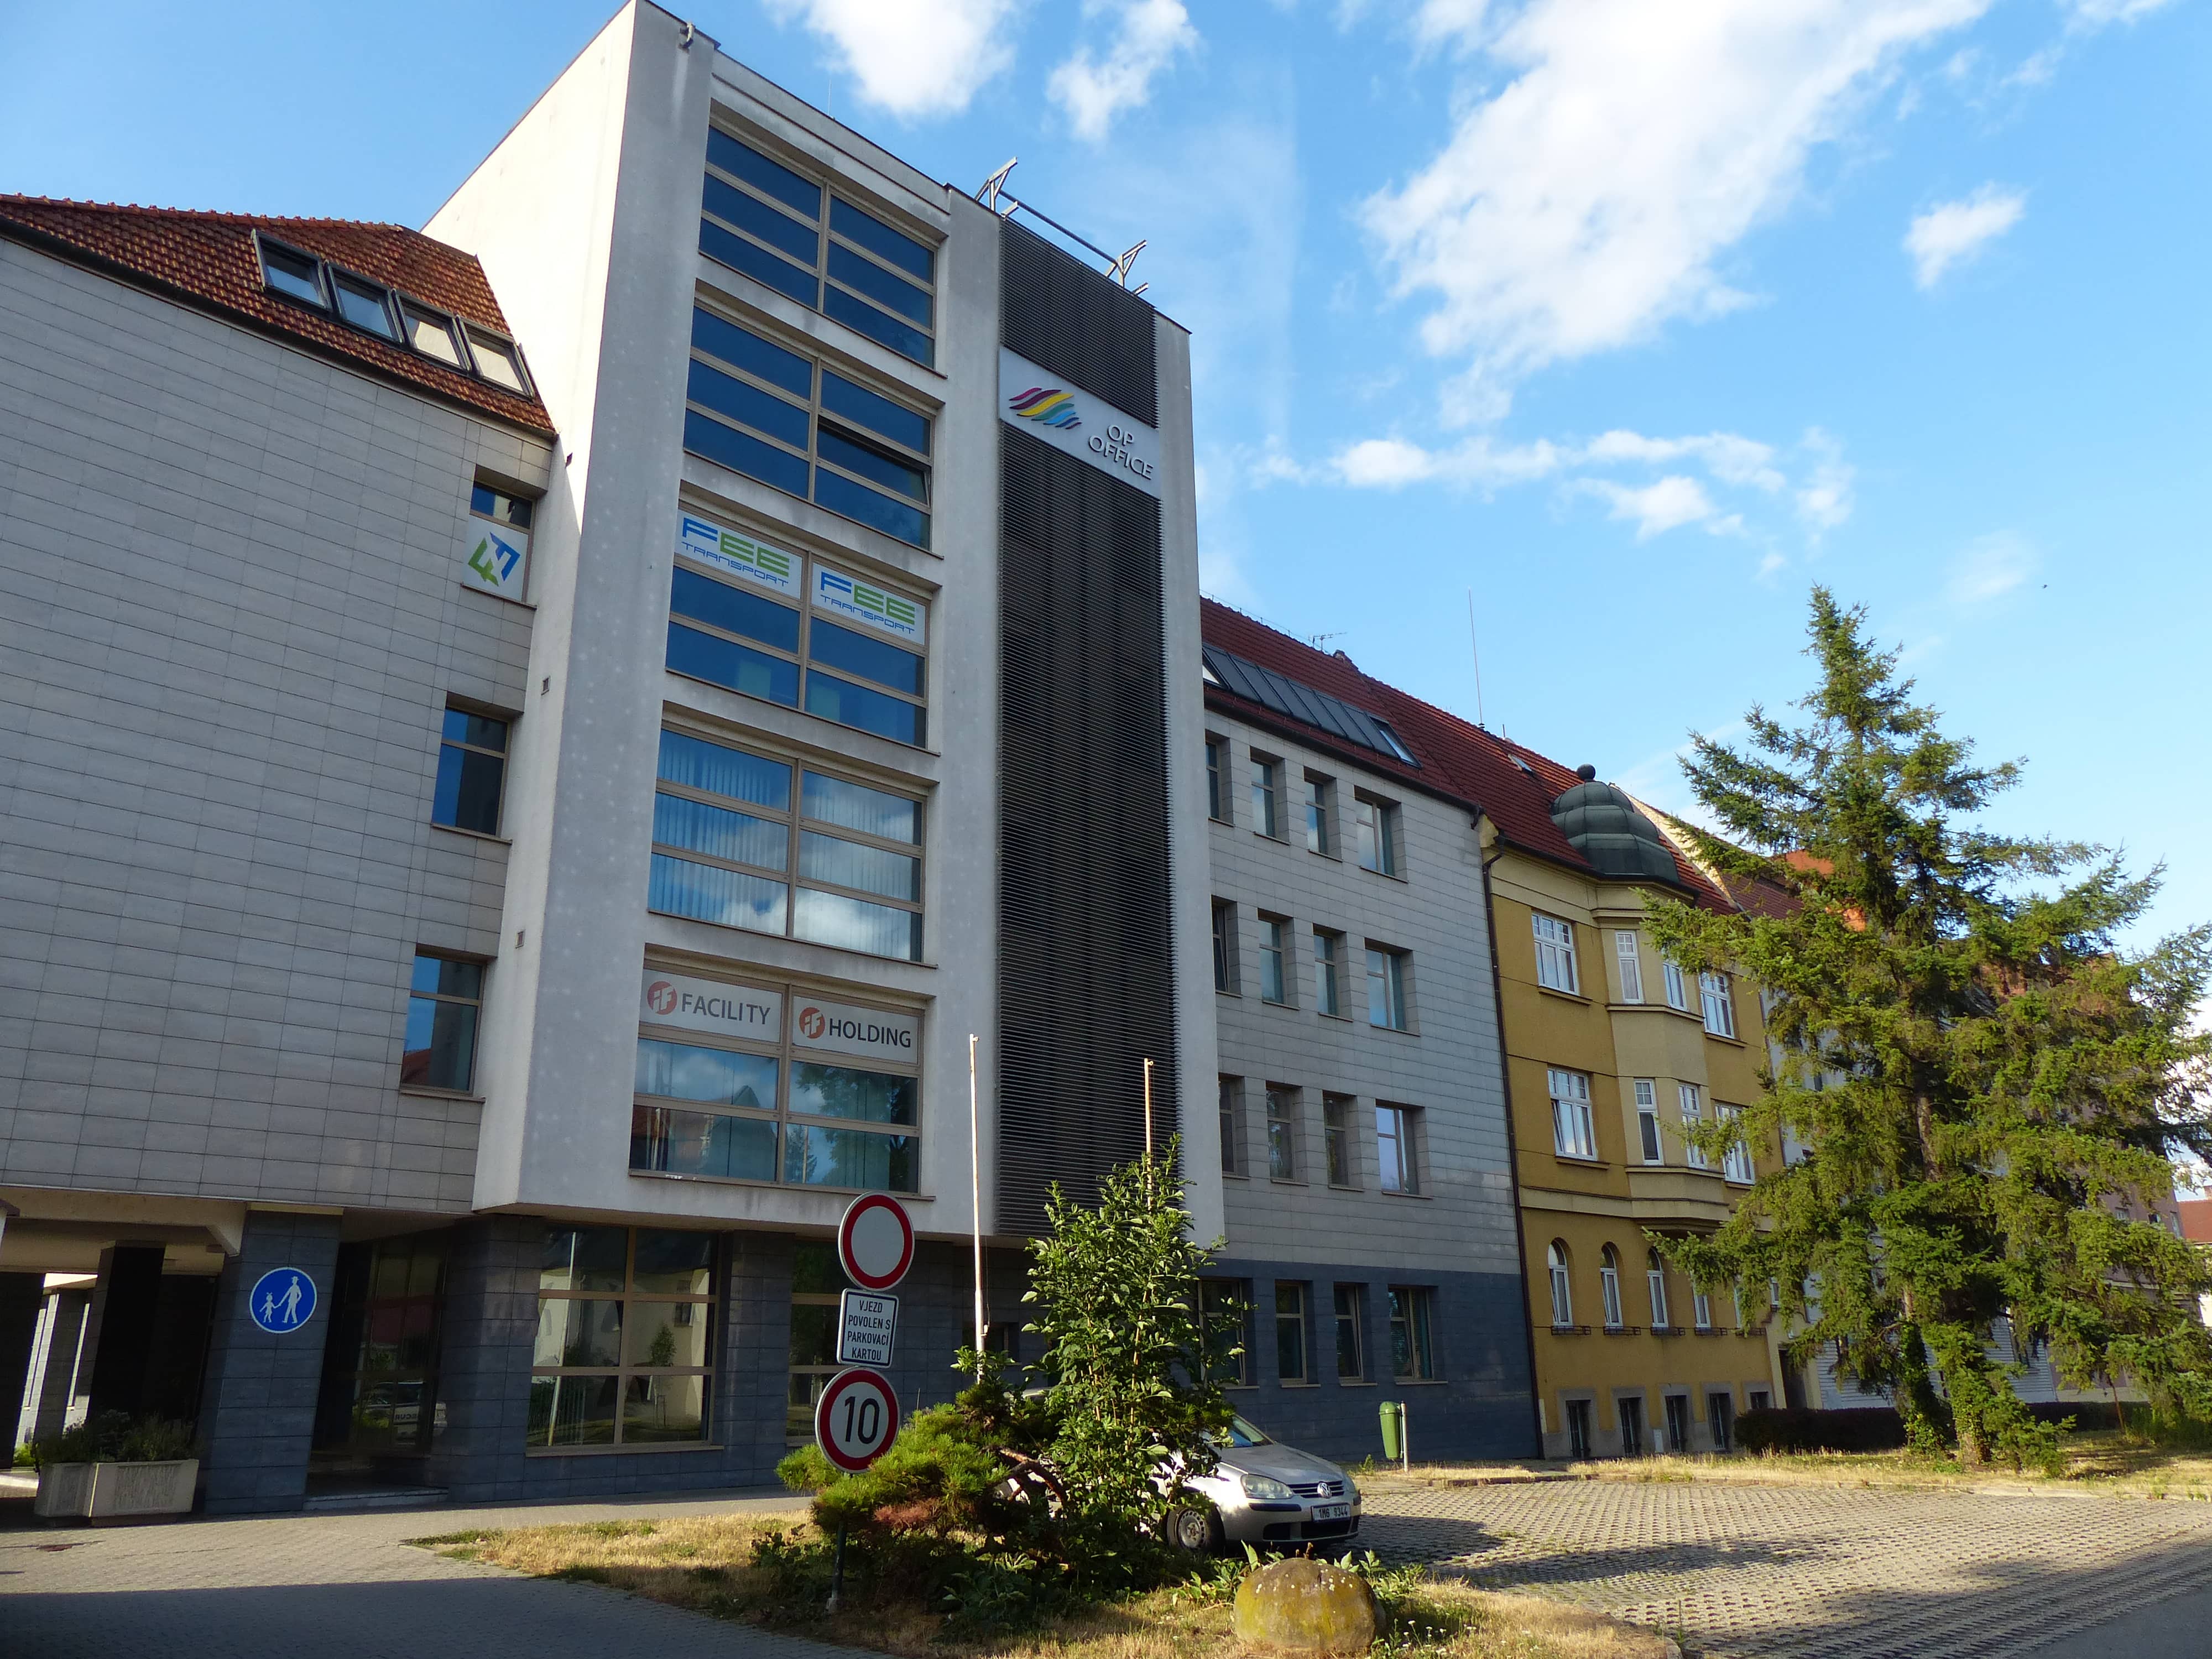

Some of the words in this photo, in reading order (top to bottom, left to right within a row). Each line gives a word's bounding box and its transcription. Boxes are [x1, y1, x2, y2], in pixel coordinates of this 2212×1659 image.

[1107, 424, 1134, 446] OP
[1088, 435, 1154, 481] OFFICE
[682, 517, 790, 578] FEE
[681, 541, 789, 587] TRANSPORT
[820, 571, 916, 625] FEE
[820, 594, 915, 634] TRANSPORT
[681, 993, 771, 1025] FACILITY
[829, 1018, 911, 1048] HOLDING
[848, 1314, 884, 1329] POVOLEN
[885, 1319, 891, 1330] S
[859, 1300, 883, 1313] VJEZD
[847, 1331, 890, 1346] PARKOVACÍ
[852, 1347, 881, 1361] KARTOU
[844, 1396, 880, 1445] 10
